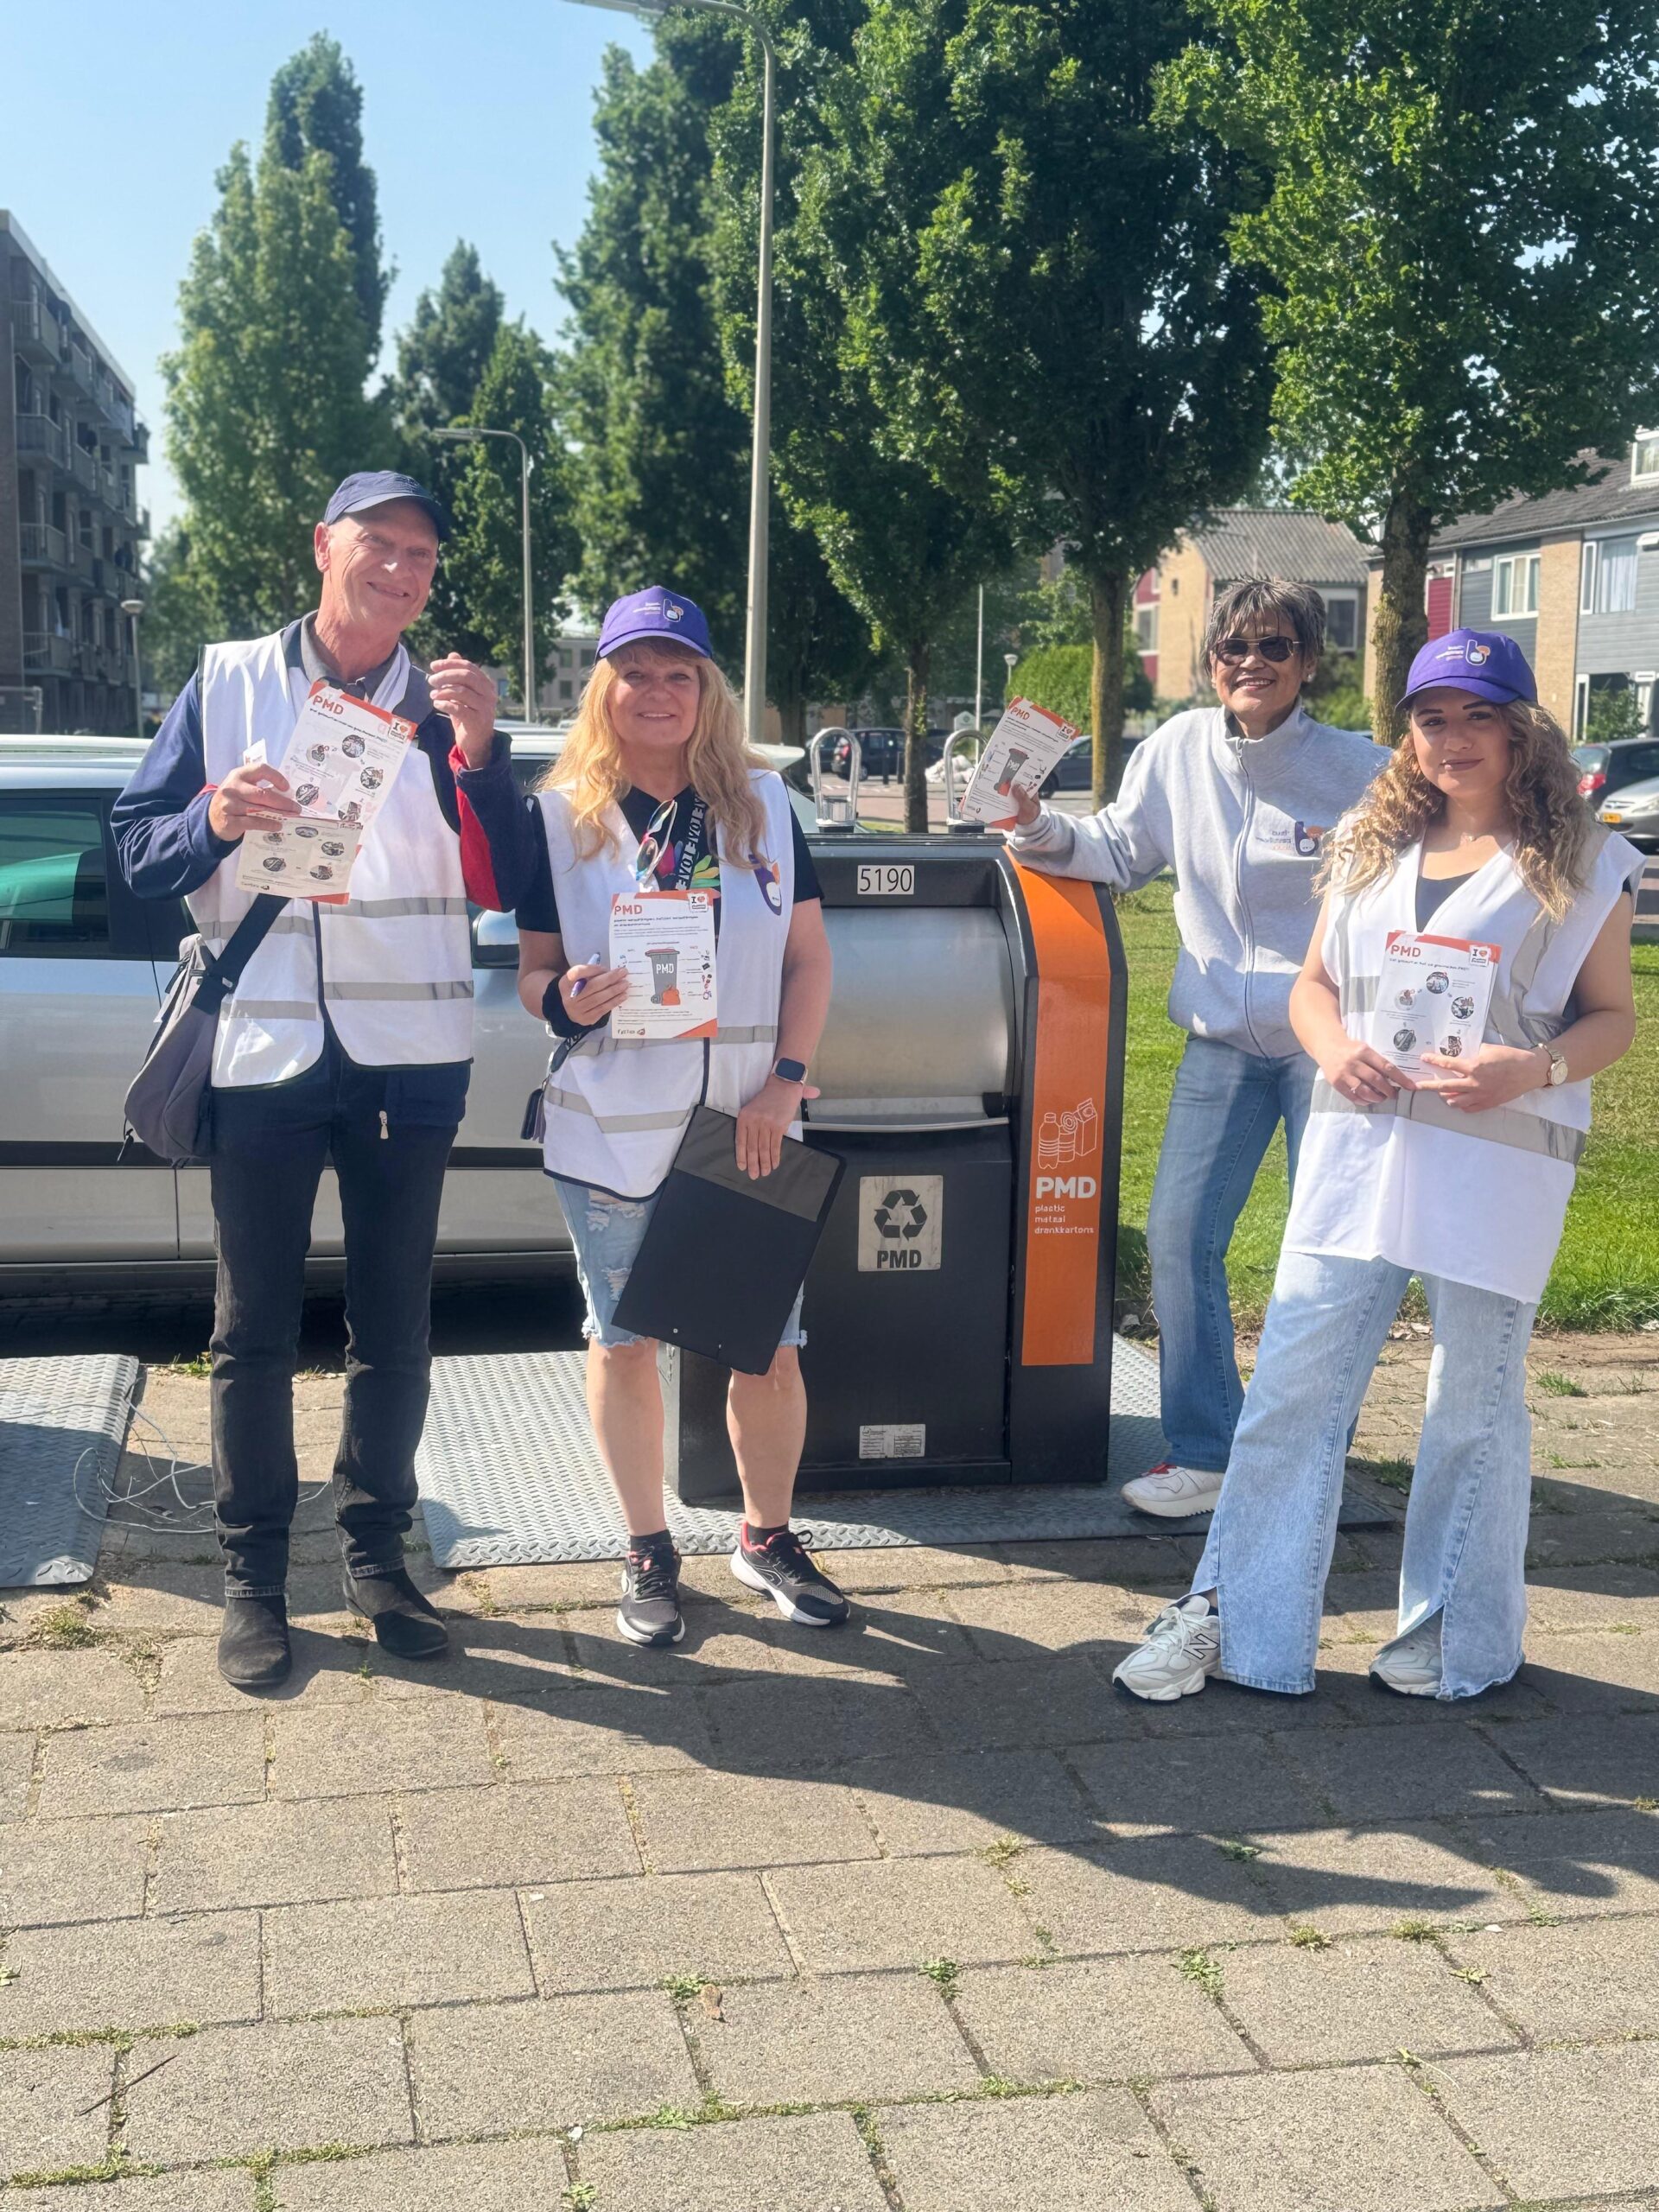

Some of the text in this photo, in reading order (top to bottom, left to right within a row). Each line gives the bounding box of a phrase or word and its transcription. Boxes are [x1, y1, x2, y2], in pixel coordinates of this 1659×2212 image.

[312, 694, 344, 715] PMD
[1010, 707, 1030, 721] PMD
[860, 868, 912, 892] 5190
[613, 905, 643, 915] PMD
[1390, 944, 1421, 957] PMD
[656, 963, 674, 974] PMD
[1036, 1176, 1096, 1199] PMD
[1035, 1205, 1065, 1214] plastic
[876, 1249, 922, 1268] PMD
